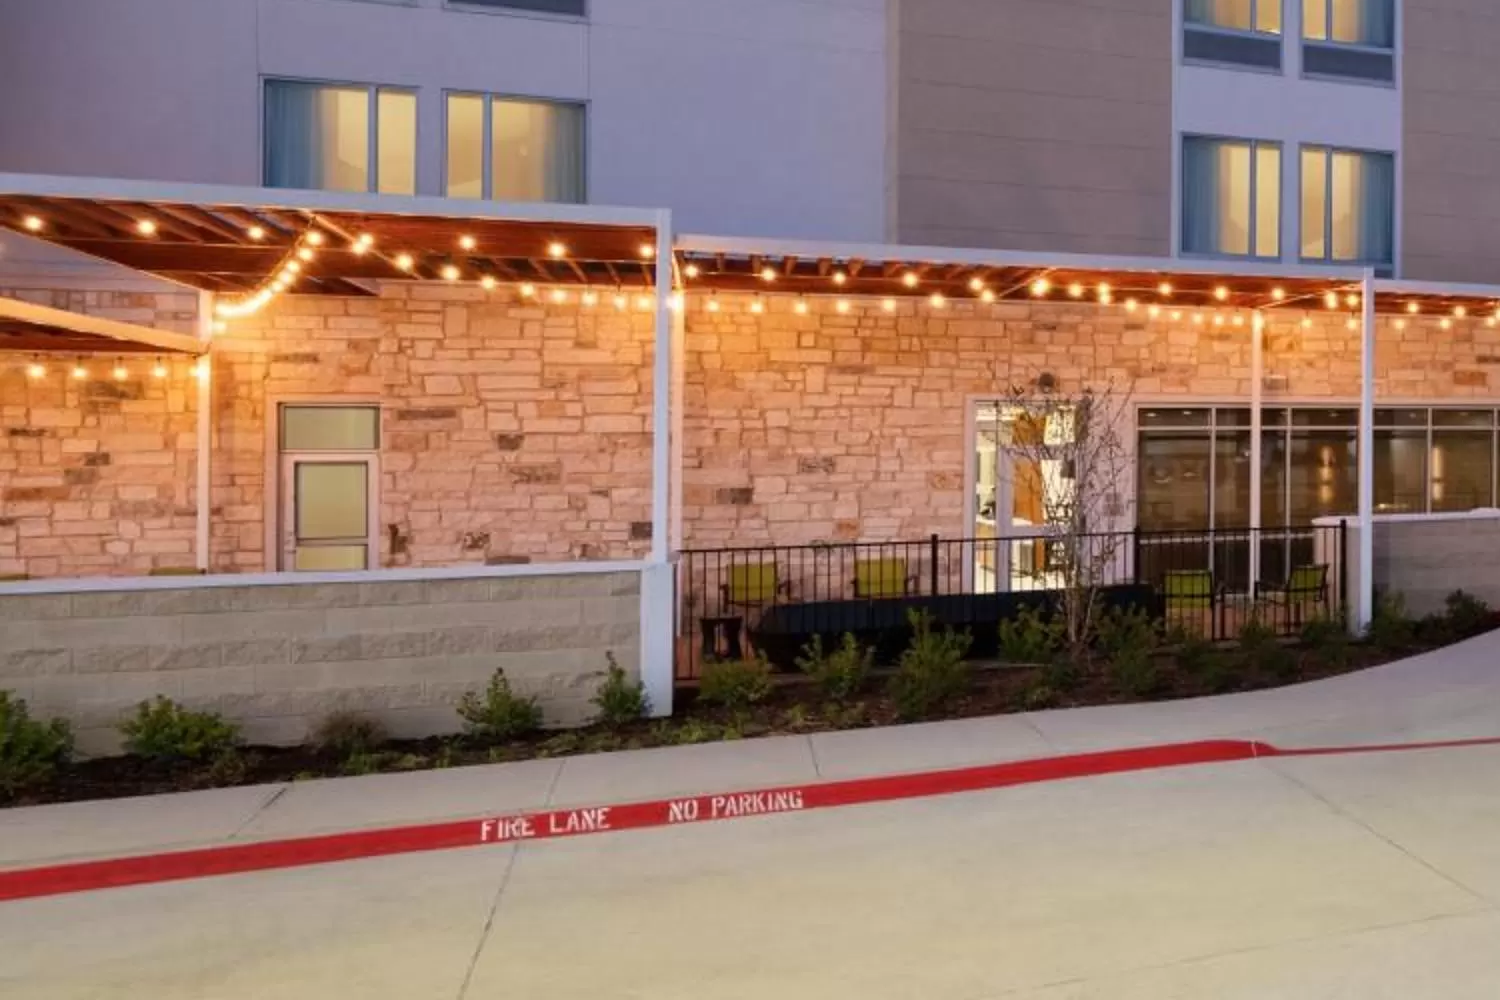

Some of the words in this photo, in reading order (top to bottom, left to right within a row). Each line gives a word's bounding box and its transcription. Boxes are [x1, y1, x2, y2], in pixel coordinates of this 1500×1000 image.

[480, 816, 535, 841] FIRE
[550, 808, 612, 834] LANE
[668, 800, 698, 823] NO
[711, 790, 804, 818] PARKING
